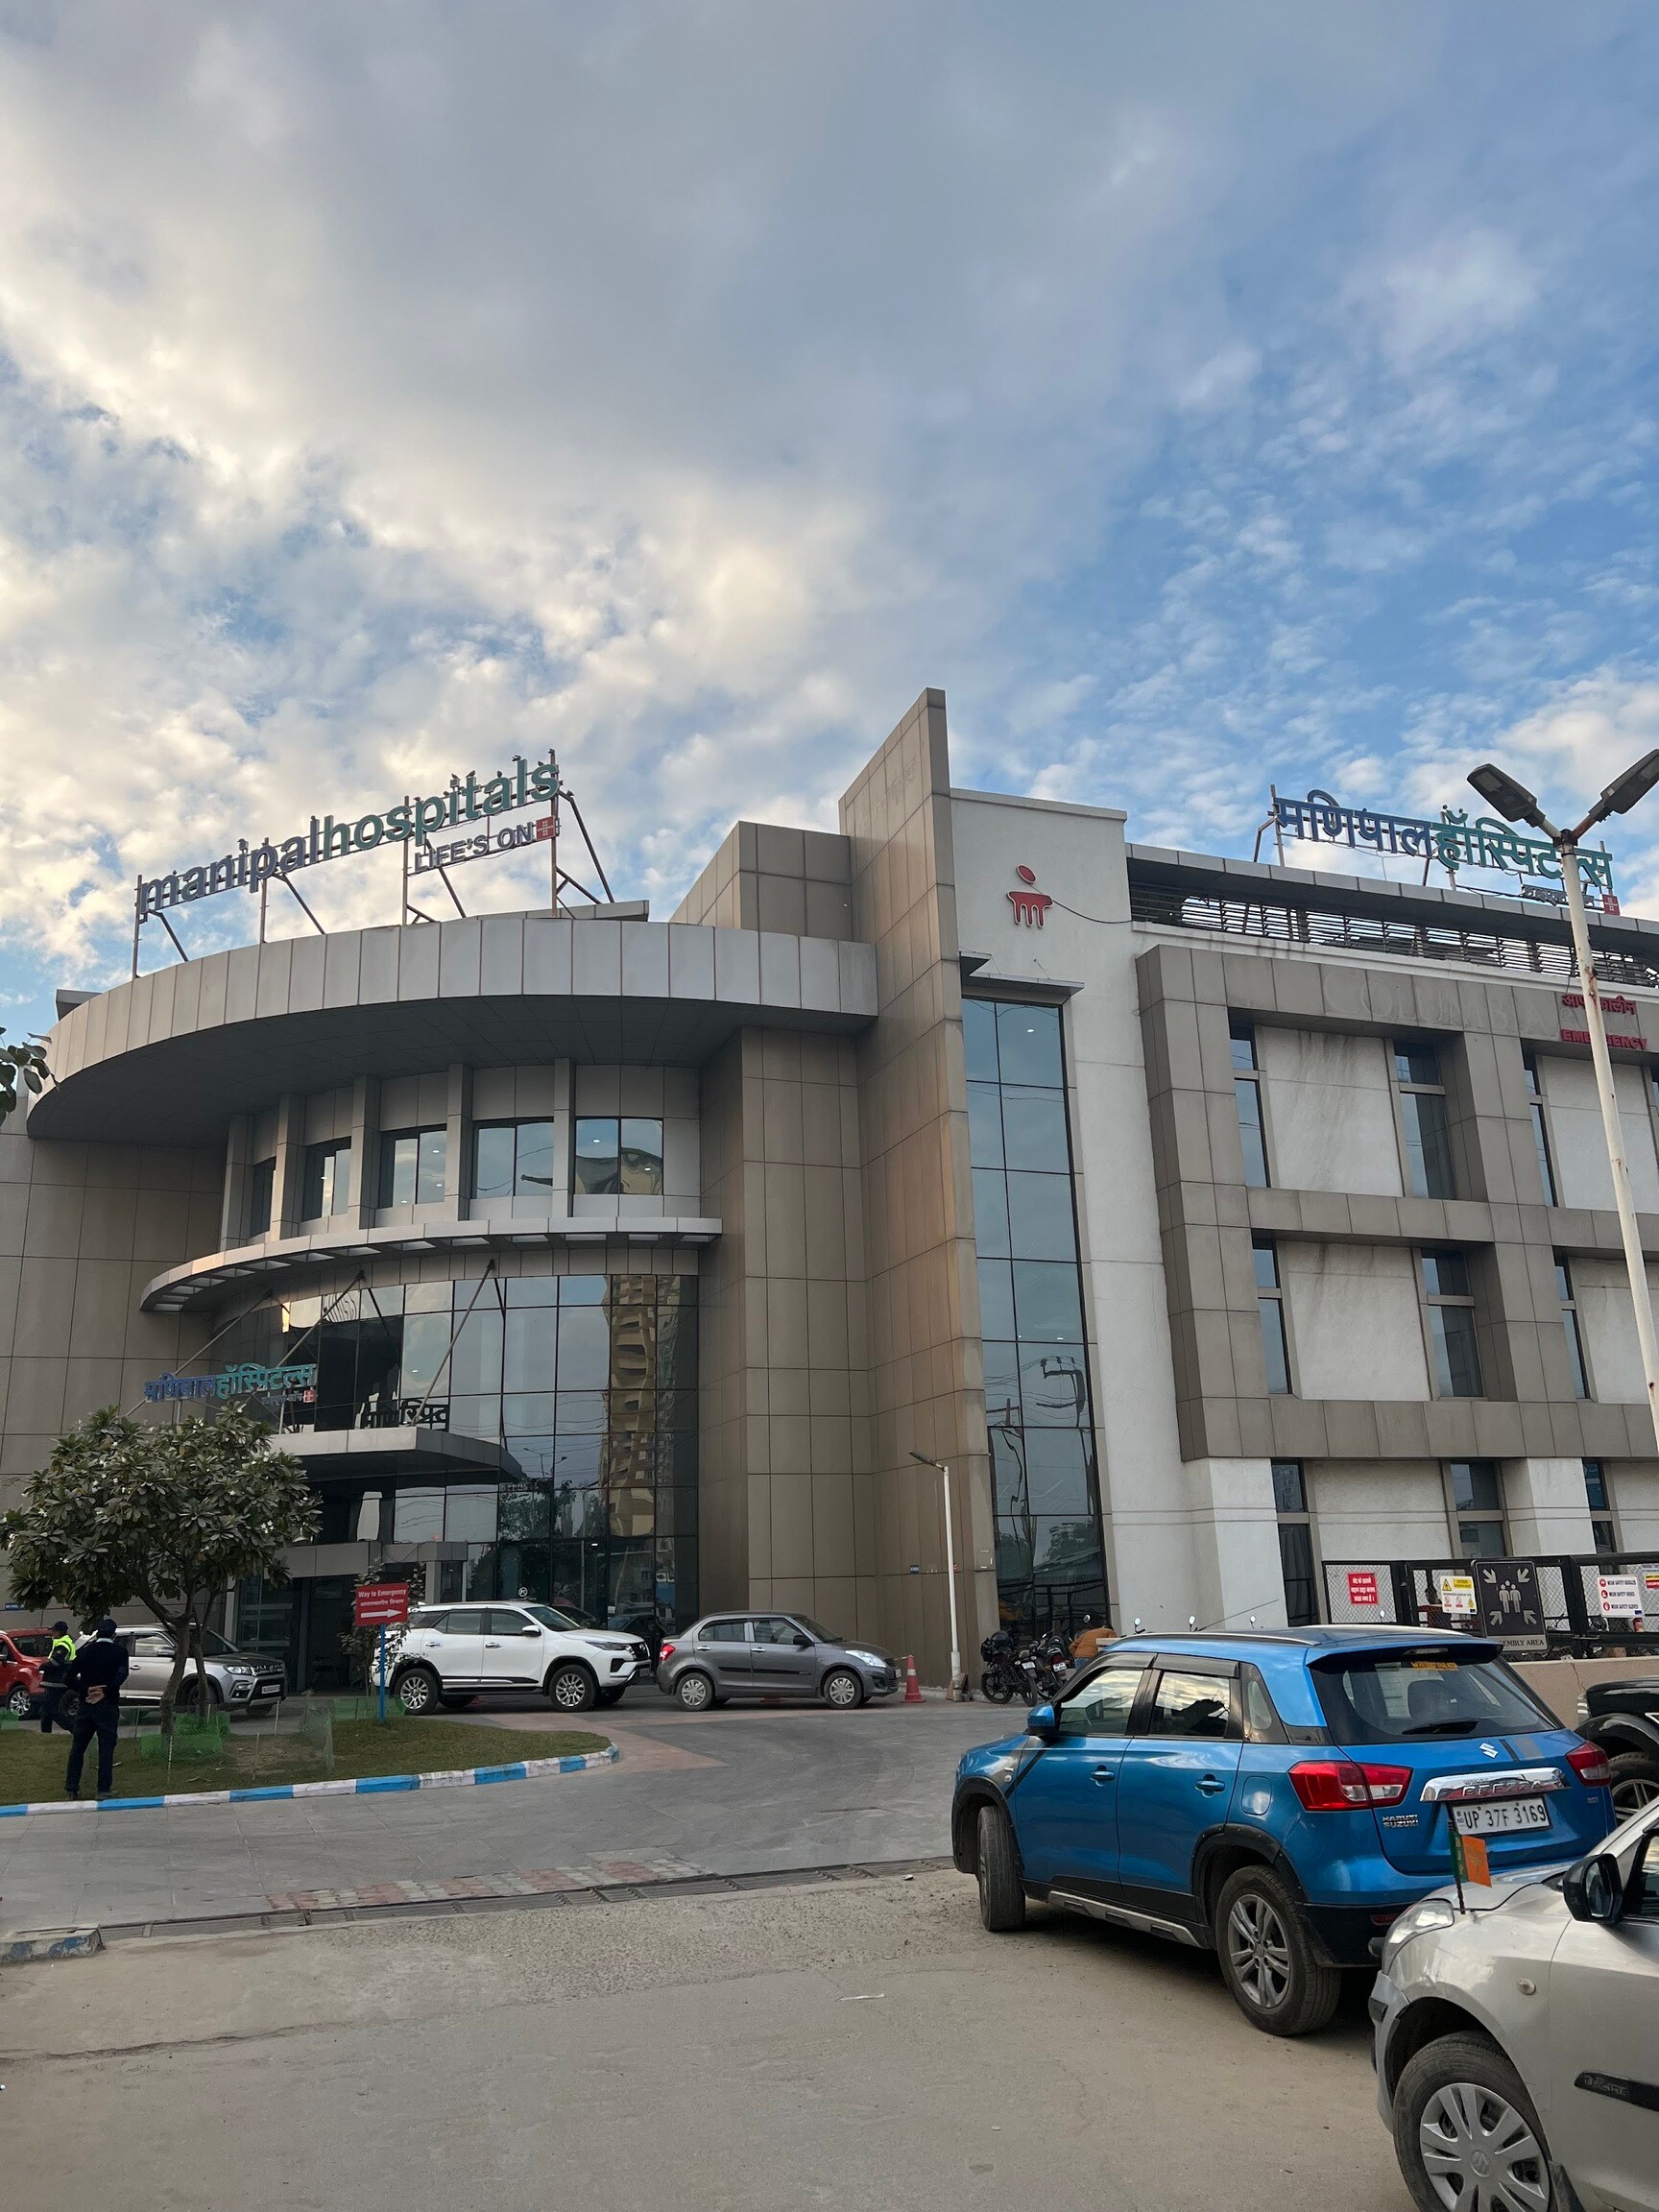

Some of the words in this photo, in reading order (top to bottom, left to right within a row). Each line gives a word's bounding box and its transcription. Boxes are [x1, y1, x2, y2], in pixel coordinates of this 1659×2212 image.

[414, 833, 489, 873] LIFE'S
[497, 821, 536, 850] ON
[1560, 1029, 1647, 1050] EMEGENCY
[1383, 1819, 1419, 1828] SUZUKI
[1464, 1811, 1479, 1829] UP
[1485, 1809, 1508, 1826] 37F
[1514, 1804, 1547, 1823] 3169
